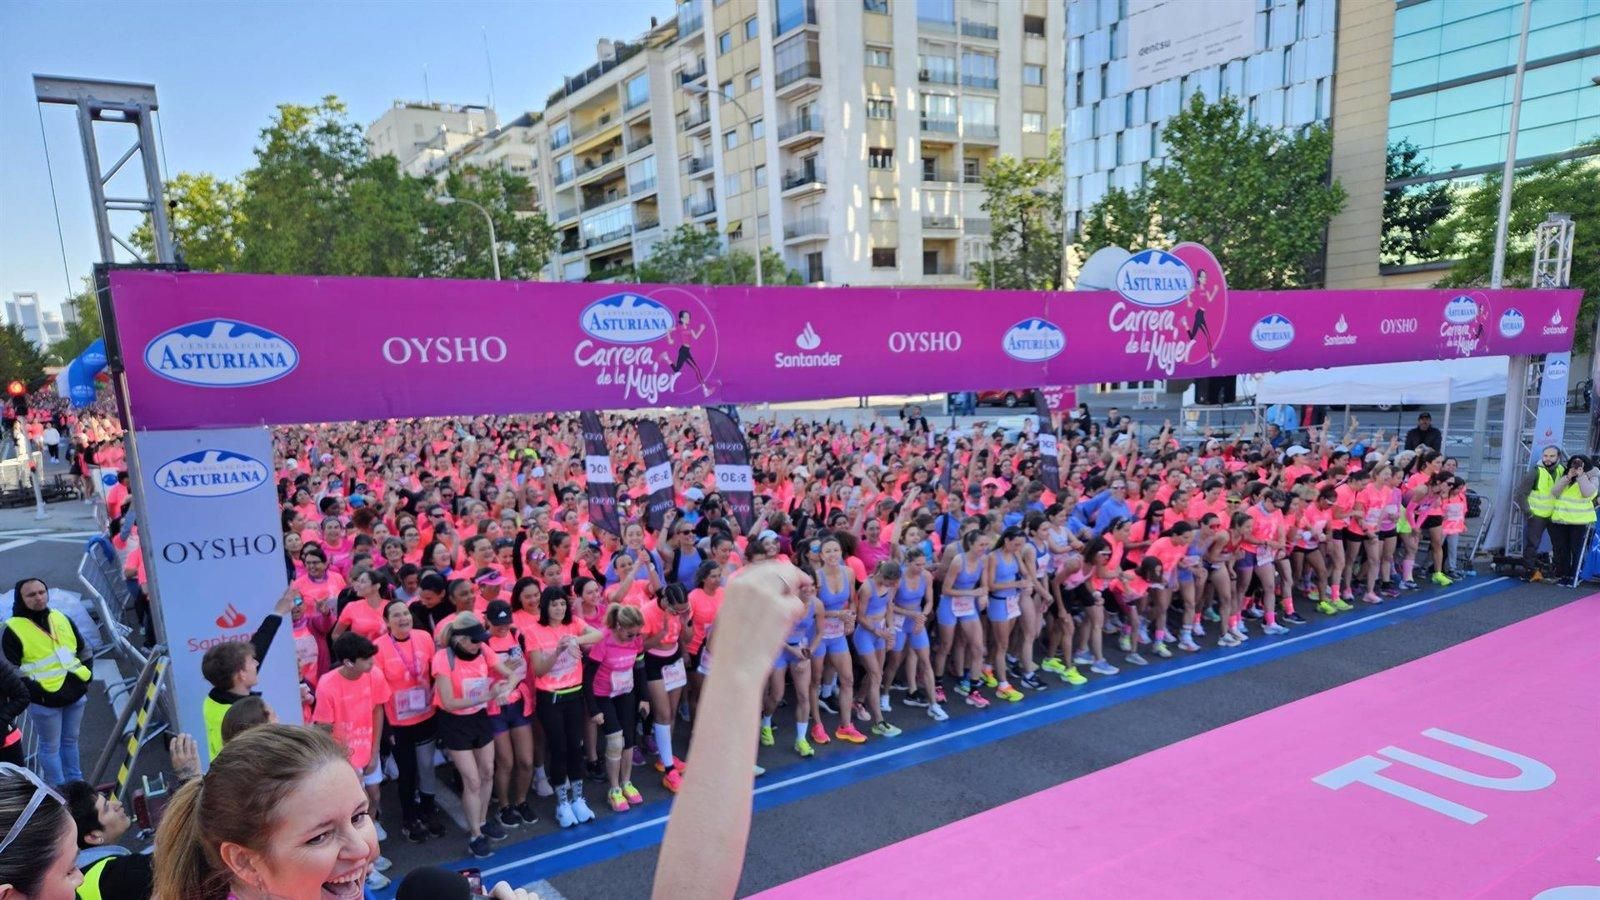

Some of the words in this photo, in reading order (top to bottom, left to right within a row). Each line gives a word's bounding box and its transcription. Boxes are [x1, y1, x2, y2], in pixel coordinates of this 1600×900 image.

[1122, 270, 1188, 291] ASTURIANA
[590, 312, 667, 331] ASTURIANA
[1109, 301, 1178, 333] Carrera
[1381, 318, 1418, 335] OYSHO
[1323, 334, 1358, 346] Santander
[1542, 325, 1569, 336] Santander
[382, 336, 508, 364] OYSHO
[574, 339, 655, 367] Carrera
[888, 331, 962, 353] OYSHO
[1008, 336, 1060, 351] ASTURIANA
[1125, 332, 1140, 354] de
[1140, 332, 1151, 353] la
[1146, 329, 1196, 376] Mujer
[159, 344, 288, 370] ASTURIANA
[775, 351, 843, 369] Santander
[596, 366, 613, 386] de
[614, 365, 626, 385] la
[623, 362, 682, 404] Mujer
[164, 469, 261, 488] ASTURIANA
[162, 533, 277, 565] OYSHO
[1311, 727, 1557, 825] TU
